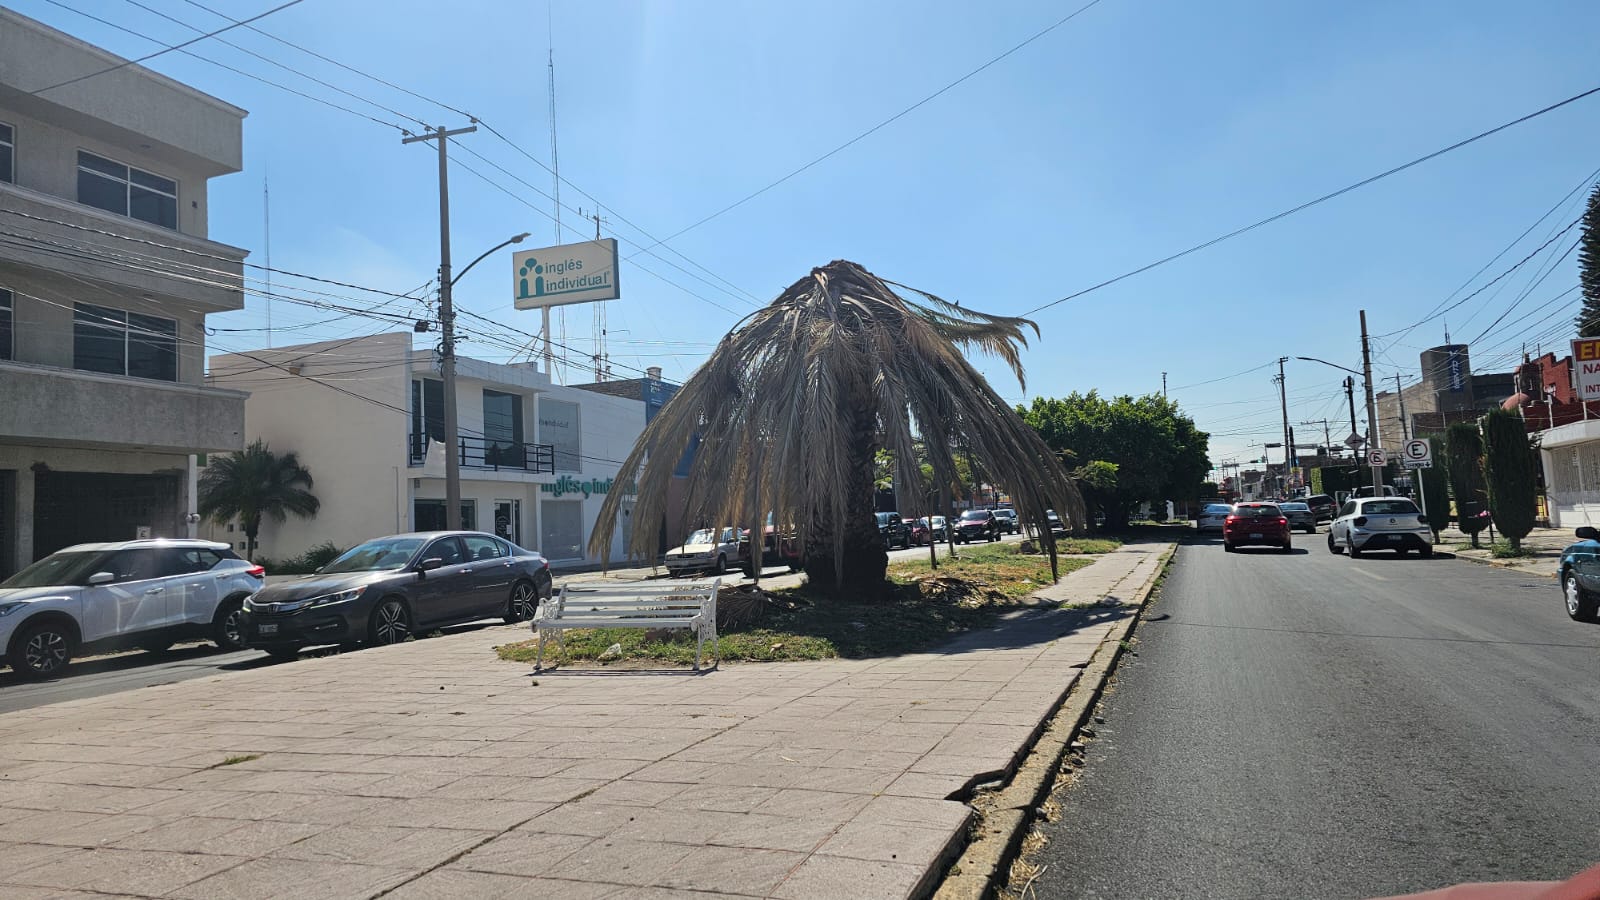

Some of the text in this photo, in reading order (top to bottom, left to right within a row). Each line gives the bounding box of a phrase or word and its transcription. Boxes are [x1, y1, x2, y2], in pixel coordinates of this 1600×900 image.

[545, 258, 583, 275] inglés
[546, 271, 607, 292] individual
[1412, 444, 1423, 456] E
